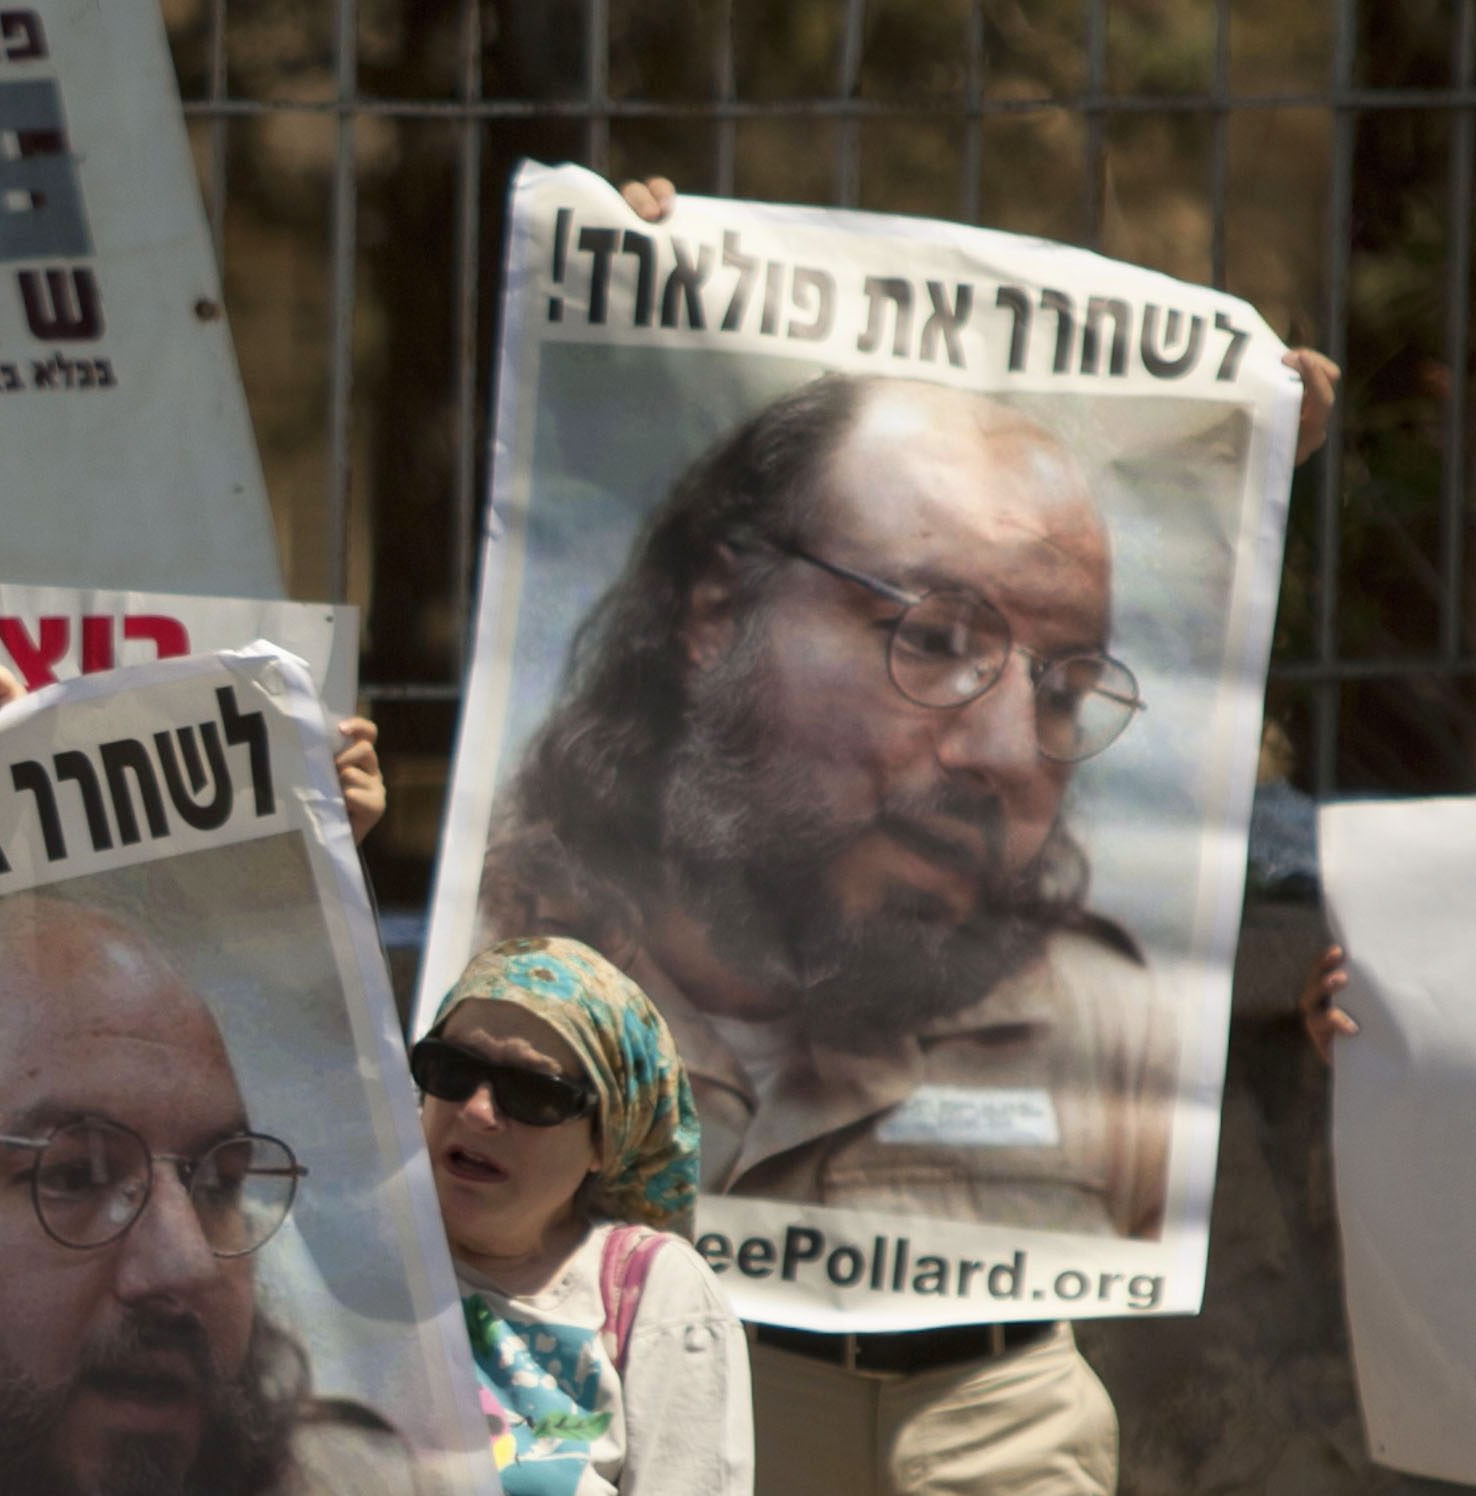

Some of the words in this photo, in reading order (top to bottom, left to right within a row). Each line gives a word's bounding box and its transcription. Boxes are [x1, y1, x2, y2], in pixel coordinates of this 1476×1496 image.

[547, 206, 839, 343] פולארד!
[858, 279, 974, 371] את
[996, 285, 1251, 383] לשחרר
[11, 684, 276, 862] לשחרר
[695, 1226, 1164, 1310] eePollard.org
